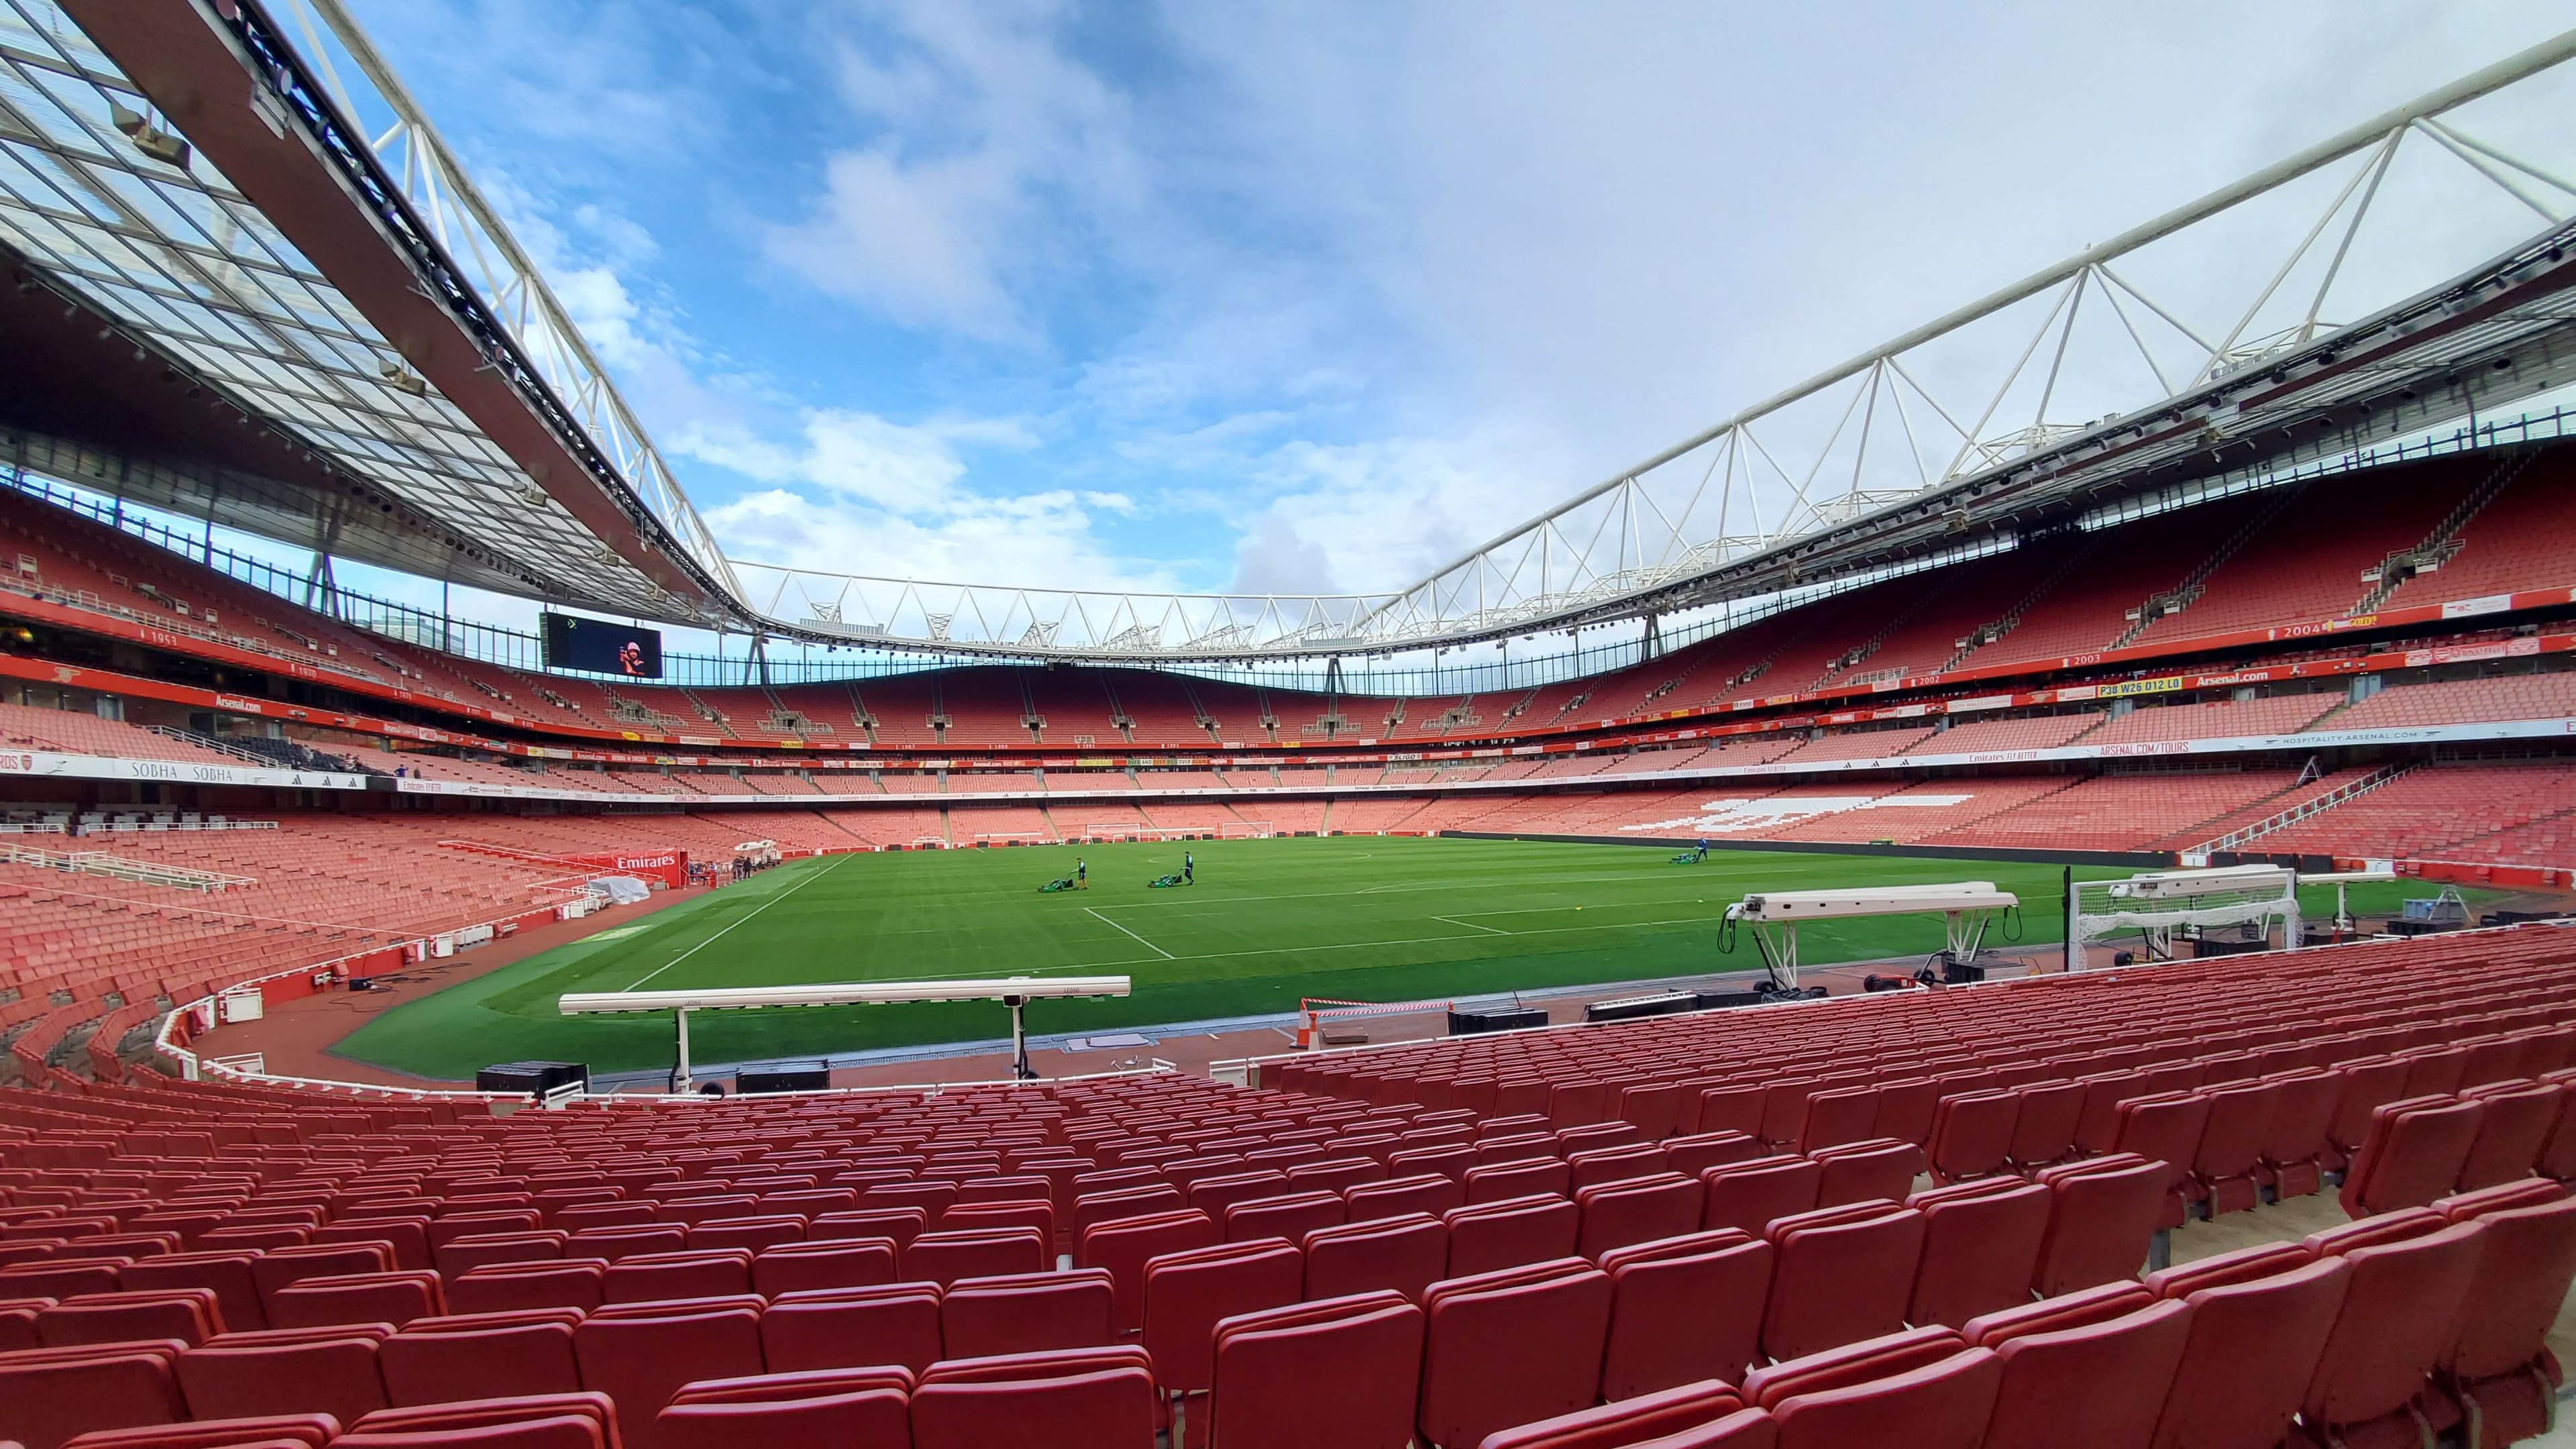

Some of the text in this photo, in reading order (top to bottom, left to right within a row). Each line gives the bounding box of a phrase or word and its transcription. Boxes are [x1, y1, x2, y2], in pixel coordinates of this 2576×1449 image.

[2284, 625, 2320, 637] 2004
[152, 631, 177, 646] 1953
[2074, 653, 2100, 665] 2003
[1919, 676, 1940, 686] 2002
[2196, 671, 2268, 686] Arsenal.com
[2100, 686, 2118, 696] P38
[2121, 683, 2141, 693] W26
[2145, 680, 2163, 690] D12
[1801, 692, 1817, 700] 2002
[216, 695, 262, 713] Arsenal.com
[2100, 741, 2189, 757] ARSENAL.COM/TOURS
[1970, 753, 2004, 763] Emirates
[2017, 751, 2037, 760] BETTER
[133, 762, 233, 782] SOBHA SOBHA
[617, 855, 676, 869] Emirates
